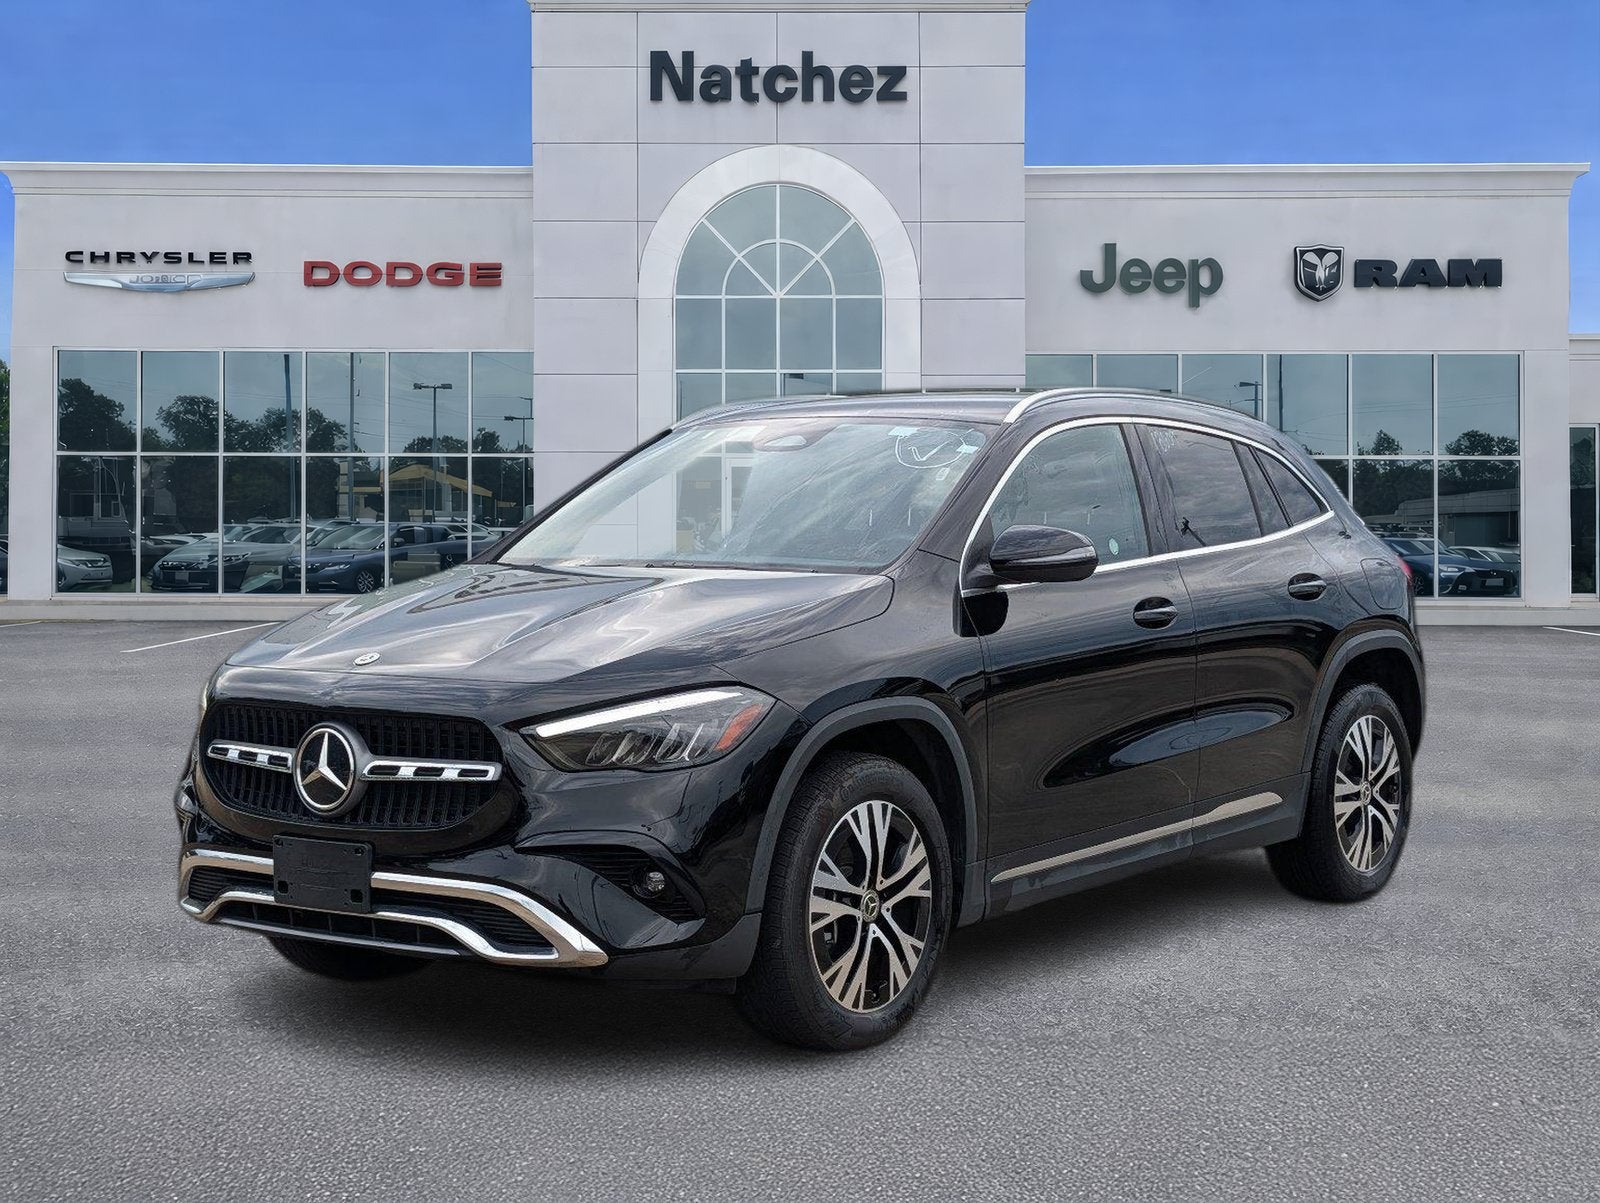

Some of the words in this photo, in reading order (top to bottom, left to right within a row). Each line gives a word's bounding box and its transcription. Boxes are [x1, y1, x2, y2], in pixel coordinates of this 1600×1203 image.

[649, 50, 907, 103] Natchez
[65, 251, 253, 265] CHRYSLER
[1354, 258, 1503, 288] RAM
[304, 260, 503, 287] DODGE
[1080, 242, 1224, 308] Jeep
